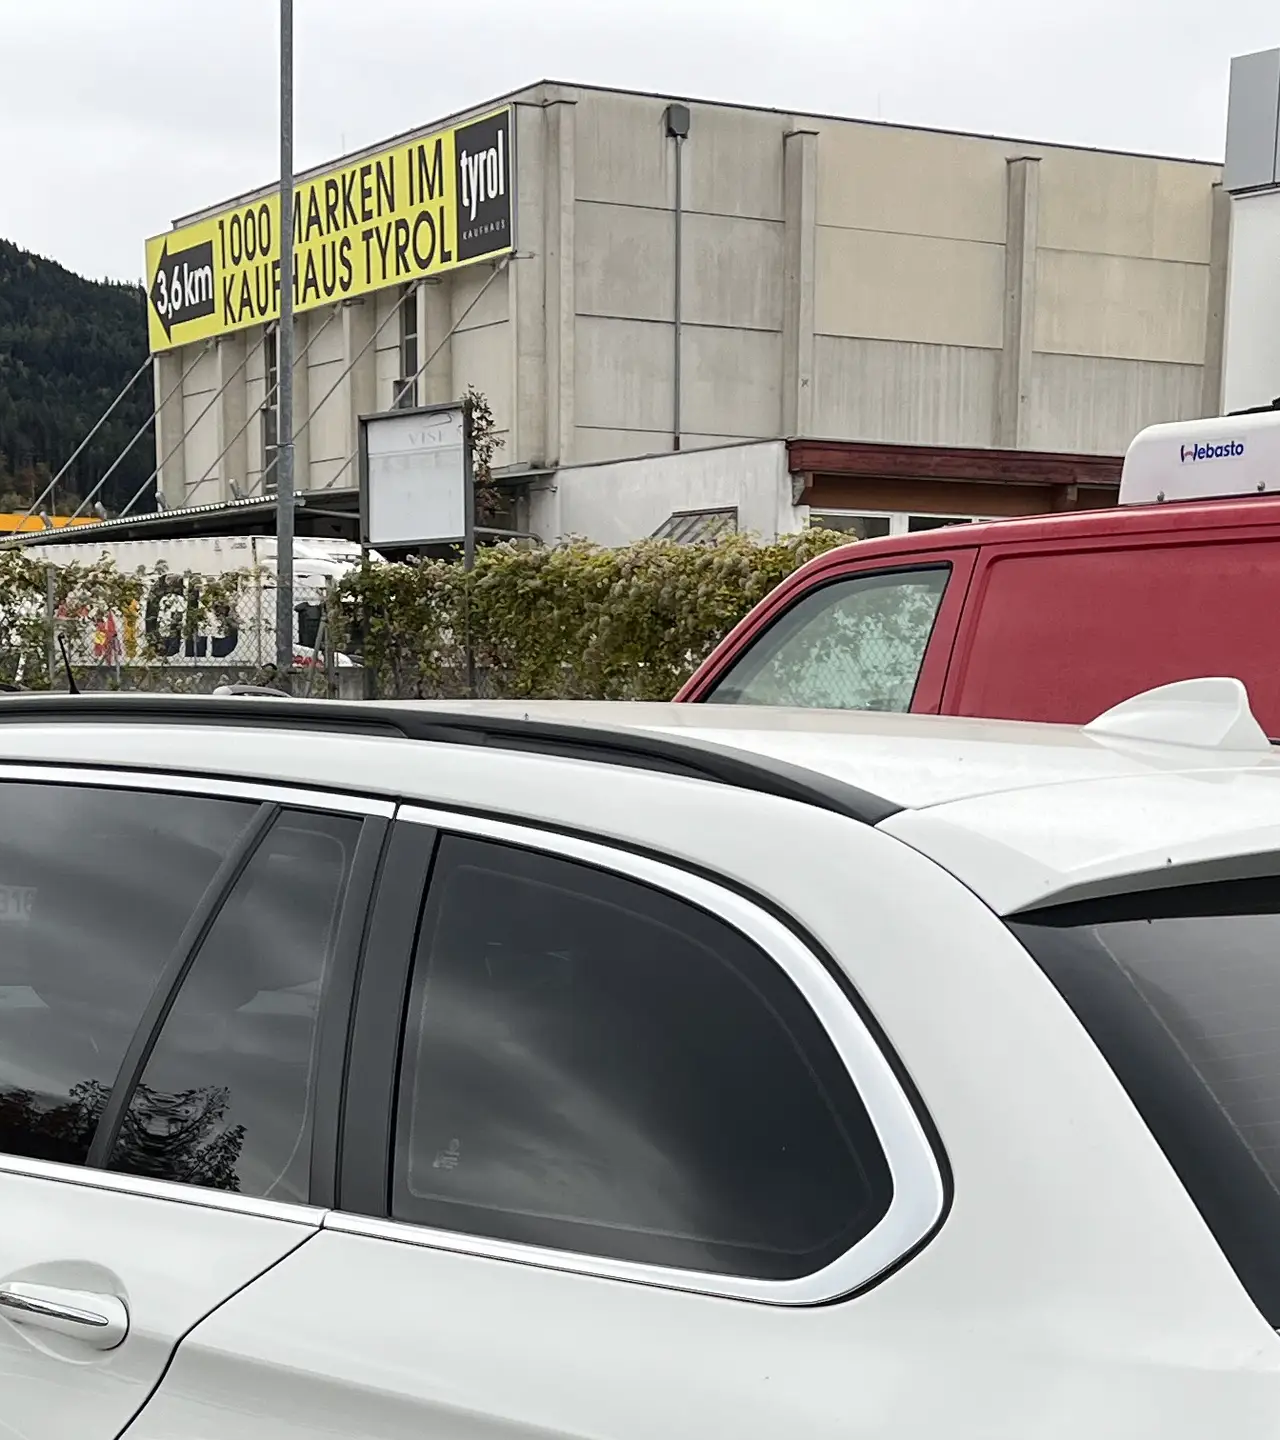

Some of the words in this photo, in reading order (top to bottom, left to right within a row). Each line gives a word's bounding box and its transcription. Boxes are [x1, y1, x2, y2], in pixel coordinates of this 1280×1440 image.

[219, 203, 271, 270] 1000
[408, 138, 444, 207] IM
[460, 129, 505, 221] tyrol
[361, 205, 452, 285] TYROL
[463, 218, 506, 240] KAUFHAUS
[1180, 440, 1244, 463] Webasto
